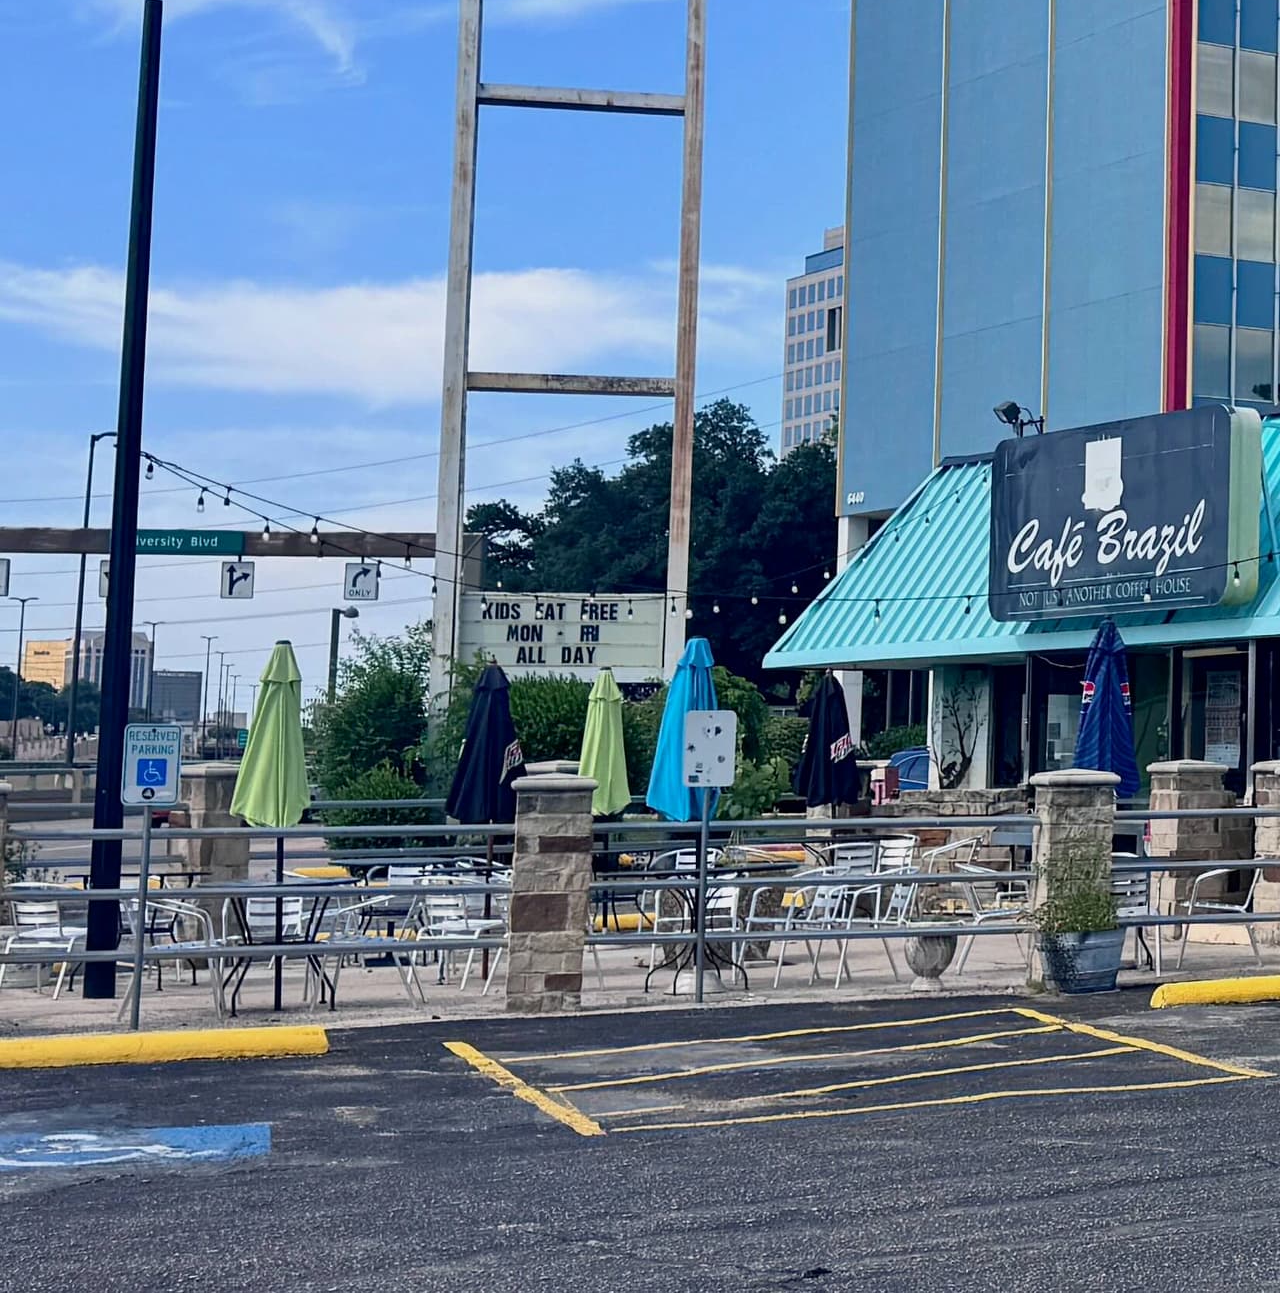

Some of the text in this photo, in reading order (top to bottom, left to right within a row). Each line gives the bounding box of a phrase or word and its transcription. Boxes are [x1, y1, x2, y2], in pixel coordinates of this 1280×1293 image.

[136, 535, 218, 550] iversity Blvd
[1007, 498, 1206, 587] Café Brazil
[348, 589, 371, 597] ONLY
[1018, 591, 1038, 607] NOT
[1043, 590, 1061, 607] JUS
[1066, 584, 1112, 604] ANOTHER
[1155, 577, 1192, 595] HOUSE
[482, 602, 618, 621] KIDS EAT FREE
[506, 624, 543, 642] MON
[516, 646, 597, 664] ALL DAY
[129, 730, 179, 742] RESERVED
[131, 744, 174, 755] PARKING
